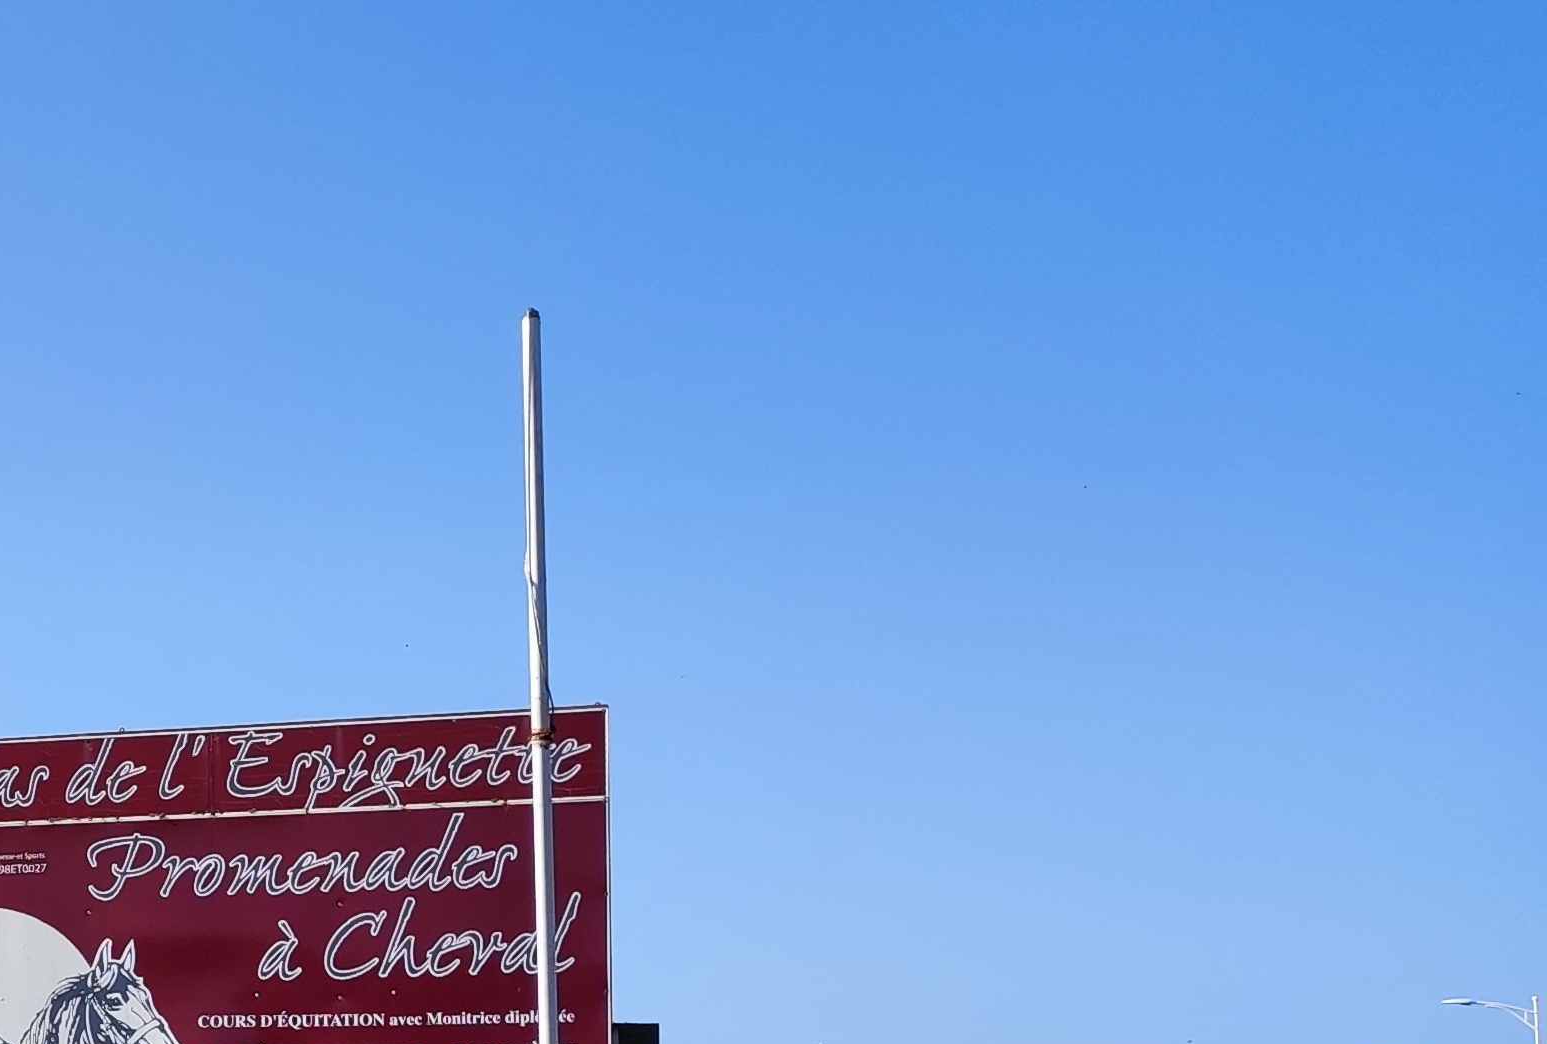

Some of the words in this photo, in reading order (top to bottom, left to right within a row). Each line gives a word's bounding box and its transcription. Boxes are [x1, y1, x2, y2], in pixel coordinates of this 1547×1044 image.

[65, 738, 147, 806] de
[86, 812, 518, 902] Promenades
[257, 920, 303, 982] à
[323, 891, 582, 981] Cheval
[197, 1014, 257, 1029] COURS
[260, 1010, 386, 1030] D'ÉQUITATION
[389, 1014, 423, 1027] avec
[425, 1010, 501, 1026] Monitrice
[504, 1009, 576, 1028] diplée
